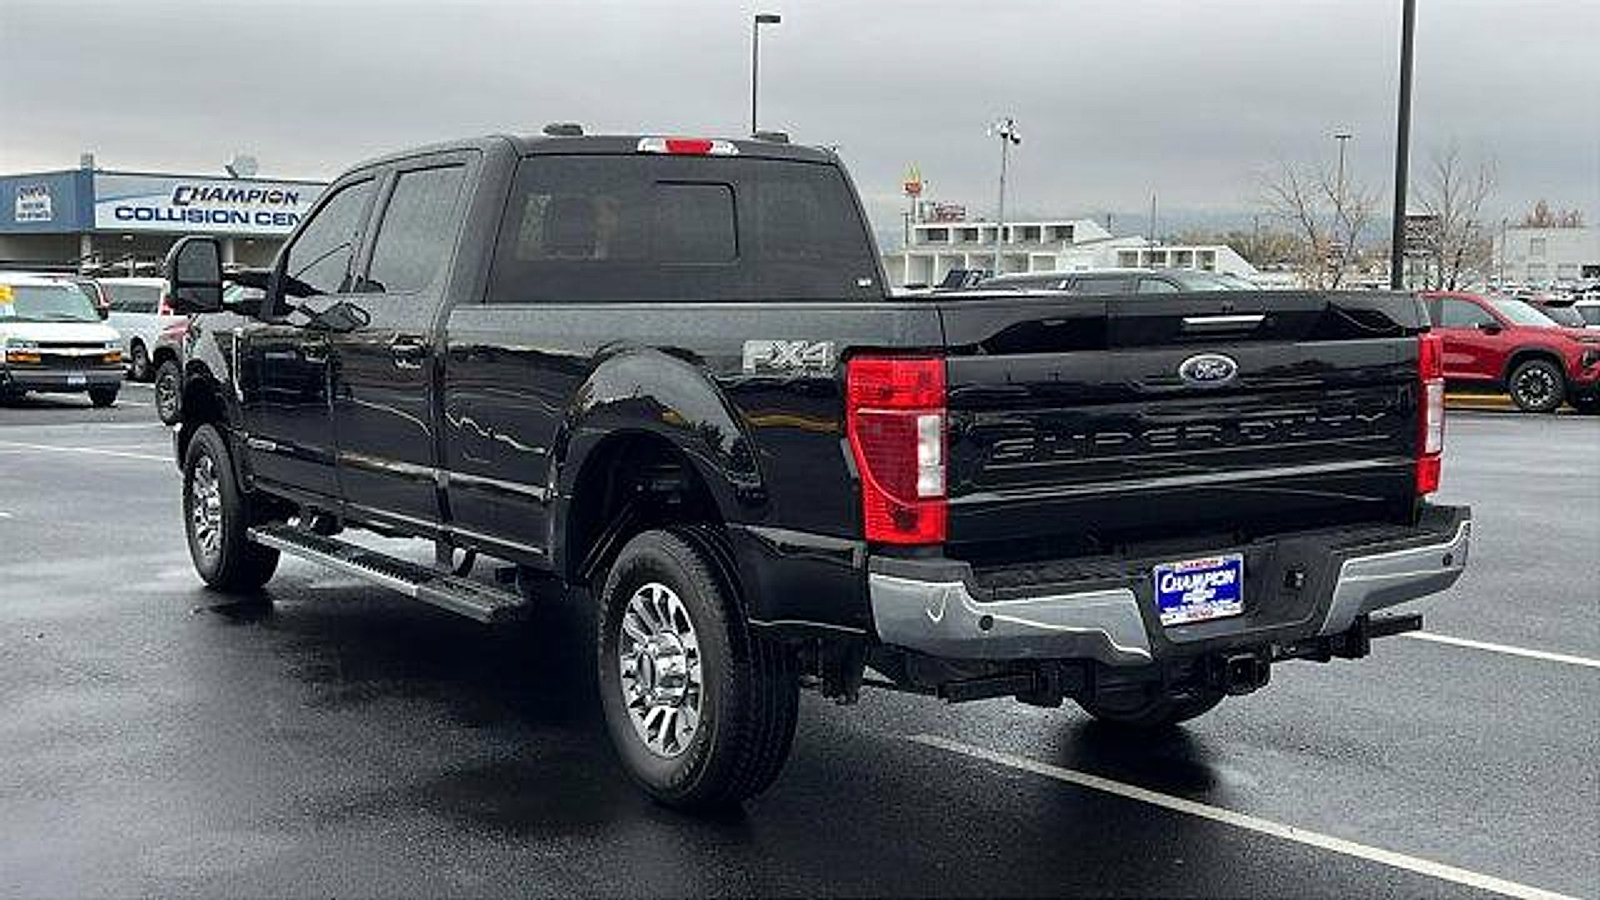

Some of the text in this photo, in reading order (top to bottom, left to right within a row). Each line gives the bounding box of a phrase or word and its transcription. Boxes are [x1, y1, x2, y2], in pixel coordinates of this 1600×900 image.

[173, 186, 299, 206] CHAMPION
[115, 207, 251, 224] COLLISION
[742, 340, 833, 375] FX4
[993, 424, 1222, 460] SUPER
[1161, 569, 1236, 593] CHAMPION
